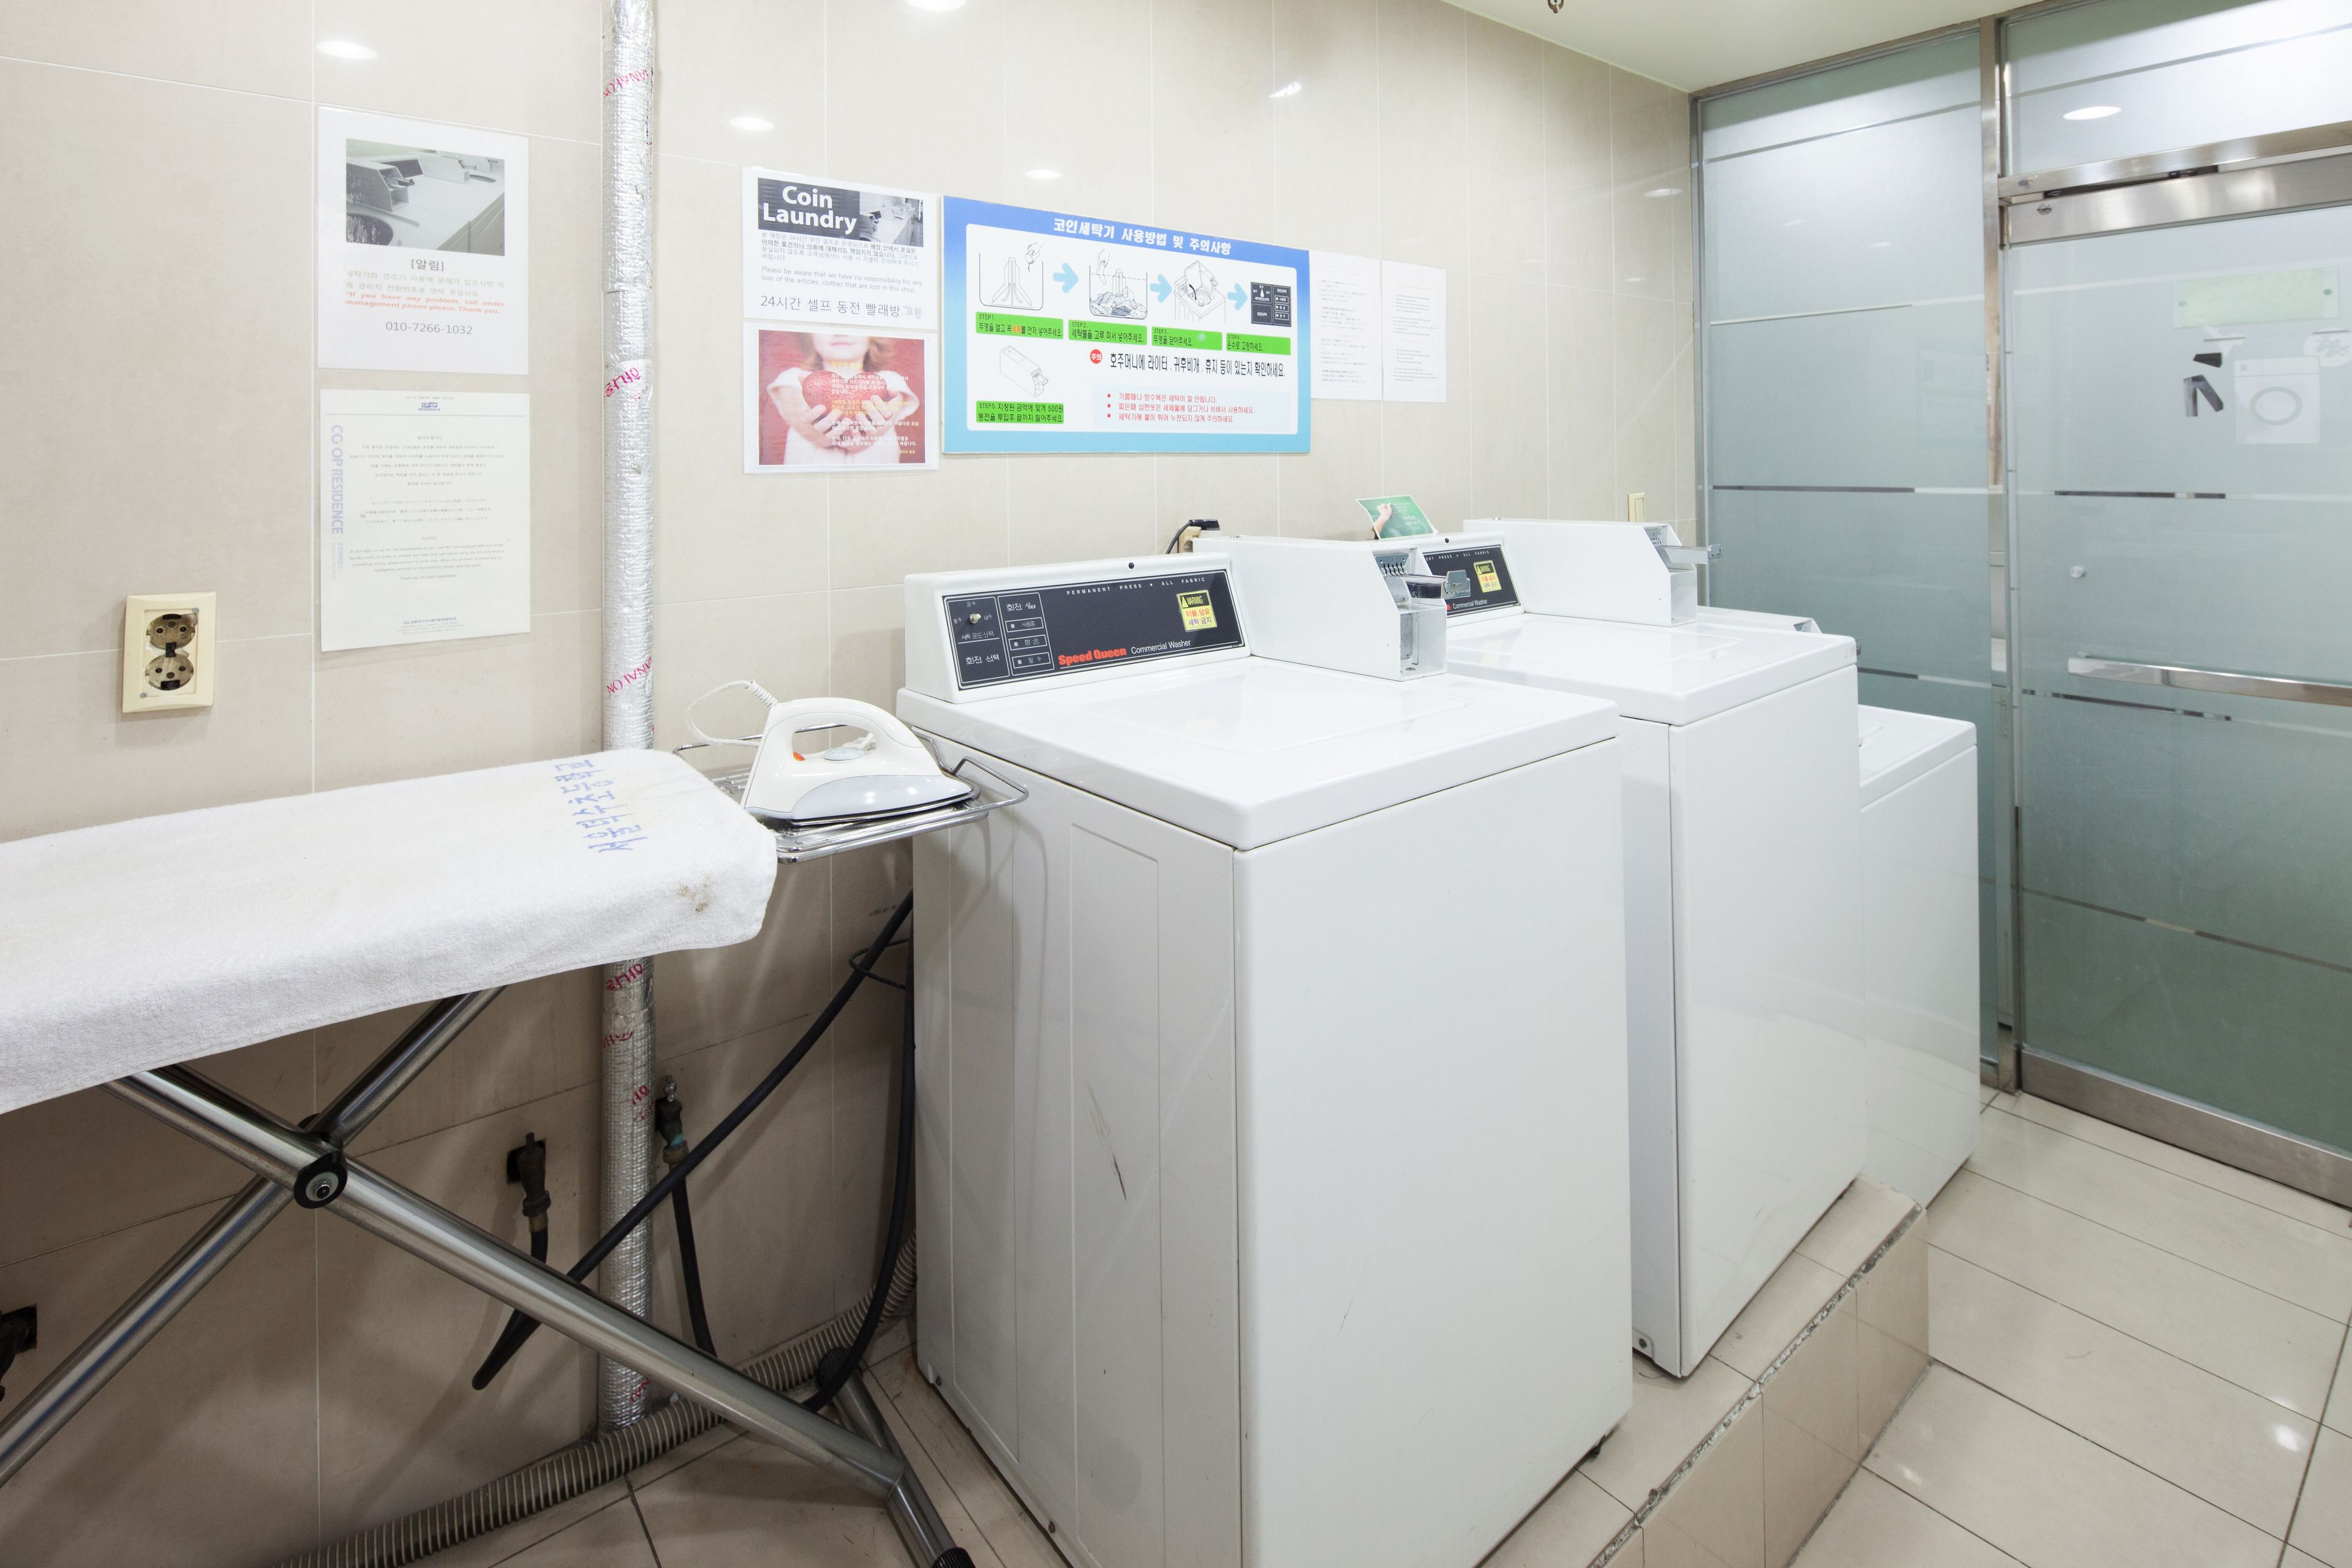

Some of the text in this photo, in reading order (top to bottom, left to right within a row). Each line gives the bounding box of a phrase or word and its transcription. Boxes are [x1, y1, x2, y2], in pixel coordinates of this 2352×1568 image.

[782, 186, 832, 209] Coin
[763, 203, 857, 235] Laundry
[1053, 218, 1115, 239] 코인세탁기
[1121, 228, 1166, 246] 사용방법
[1189, 238, 1231, 255] 주의사항
[412, 259, 444, 271] [알림]
[864, 276, 902, 285] responsibility
[358, 282, 382, 291] 관리자
[386, 284, 426, 293] 전화번호로
[761, 295, 802, 311] 24시간
[807, 298, 832, 312] 셀프
[837, 301, 861, 315] 동전
[865, 303, 900, 317] 빨래방
[386, 321, 472, 335] 010-7266-1032
[979, 322, 1062, 337] 뚜껑을 열고 먼저 넣어주세요.
[1072, 328, 1092, 340] 세탁물을
[1095, 331, 1104, 339] 고루
[1118, 332, 1144, 343] 넣어주세요.
[1153, 334, 1194, 347] 뚜껑을 닫아주세요.
[1227, 341, 1264, 352] 온수로 고정하세요.
[1110, 353, 1285, 377] 호주머니에 라이터 귀후비개 휴지 등이 있는지 확인하세요.
[998, 403, 1015, 412] 지정된
[1017, 403, 1033, 412] 금액에
[1035, 404, 1046, 412] 맞게
[978, 413, 1064, 423] 동전을 투입후 끝까지 밀어주세요.
[331, 469, 344, 535] RESIDENCE
[1066, 586, 1111, 595] PERMANENT
[1186, 596, 1204, 606] WARNING
[1452, 598, 1488, 610] Commercial Washer
[1200, 616, 1212, 625] 금지
[1058, 639, 1191, 666] Speed Queen Commercial Washer
[965, 654, 1000, 665] 회전 선택
